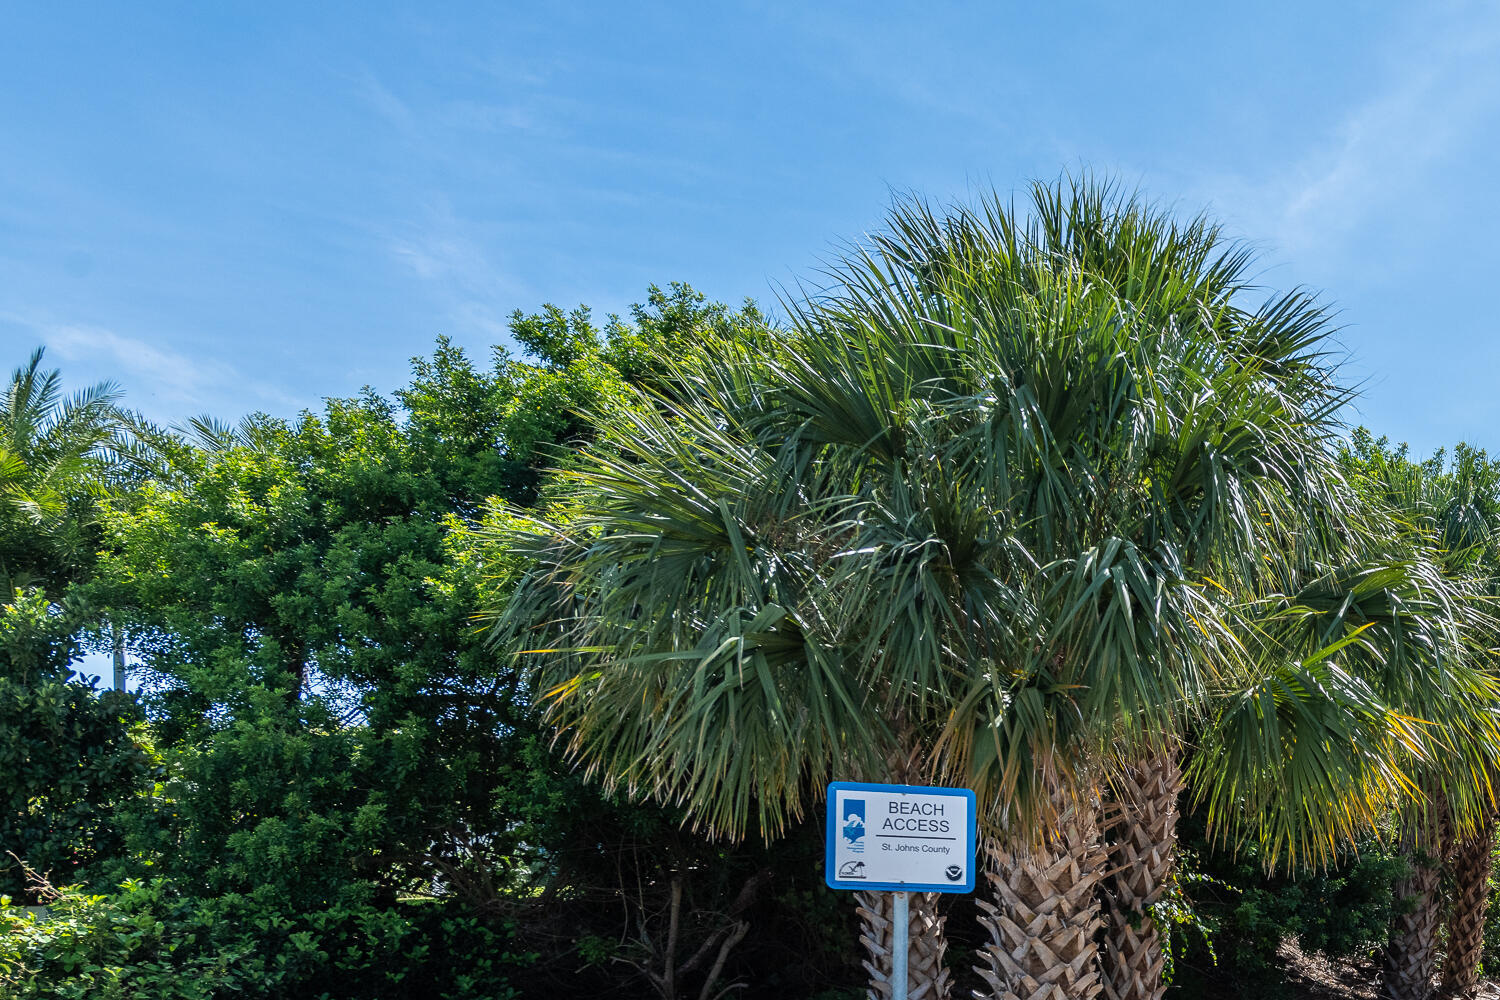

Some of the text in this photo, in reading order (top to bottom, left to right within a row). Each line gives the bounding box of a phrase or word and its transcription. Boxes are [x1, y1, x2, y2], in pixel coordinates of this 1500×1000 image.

[889, 801, 944, 816] BEACH
[882, 817, 950, 833] ACCESS
[881, 842, 951, 856] St. Johns County
